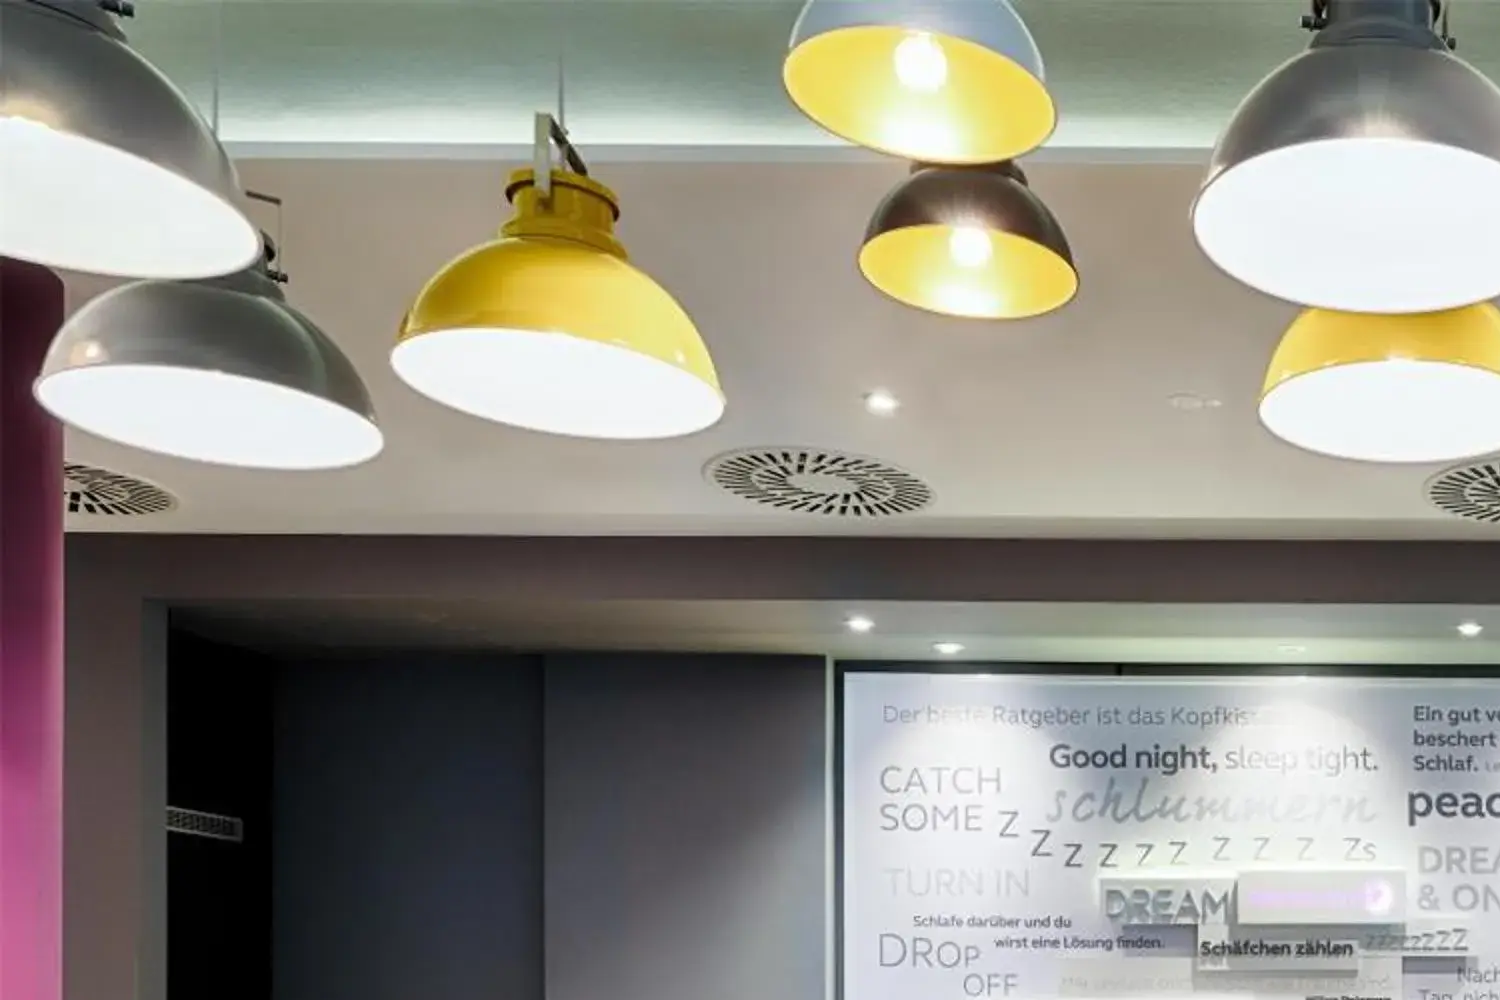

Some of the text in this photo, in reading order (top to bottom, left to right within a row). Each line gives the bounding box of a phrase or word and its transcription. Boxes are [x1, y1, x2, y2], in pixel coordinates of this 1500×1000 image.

[882, 705, 921, 724] Der
[992, 705, 1090, 730] Ratgeber
[1096, 704, 1121, 725] ist
[1127, 704, 1165, 725] das
[1171, 705, 1257, 729] Kopfkis
[1413, 706, 1444, 722] Ein
[1448, 706, 1481, 726] gut
[1413, 730, 1496, 748] beschert
[1049, 743, 1379, 776] Good night, sleep tight.
[1413, 755, 1479, 773] Schlaf.
[880, 766, 1002, 795] CATCH
[1046, 778, 1378, 824] schlummern
[880, 804, 983, 832] SOME
[886, 869, 1029, 896] TURN IN
[1104, 887, 1229, 922] DREAM
[1417, 885, 1440, 912] &
[913, 915, 1072, 928] Schlafe darüber und du
[994, 936, 1165, 951] wirst eine Lösung finden.
[1200, 941, 1353, 957] Schäfchen zählen
[964, 974, 1019, 996] OFF
